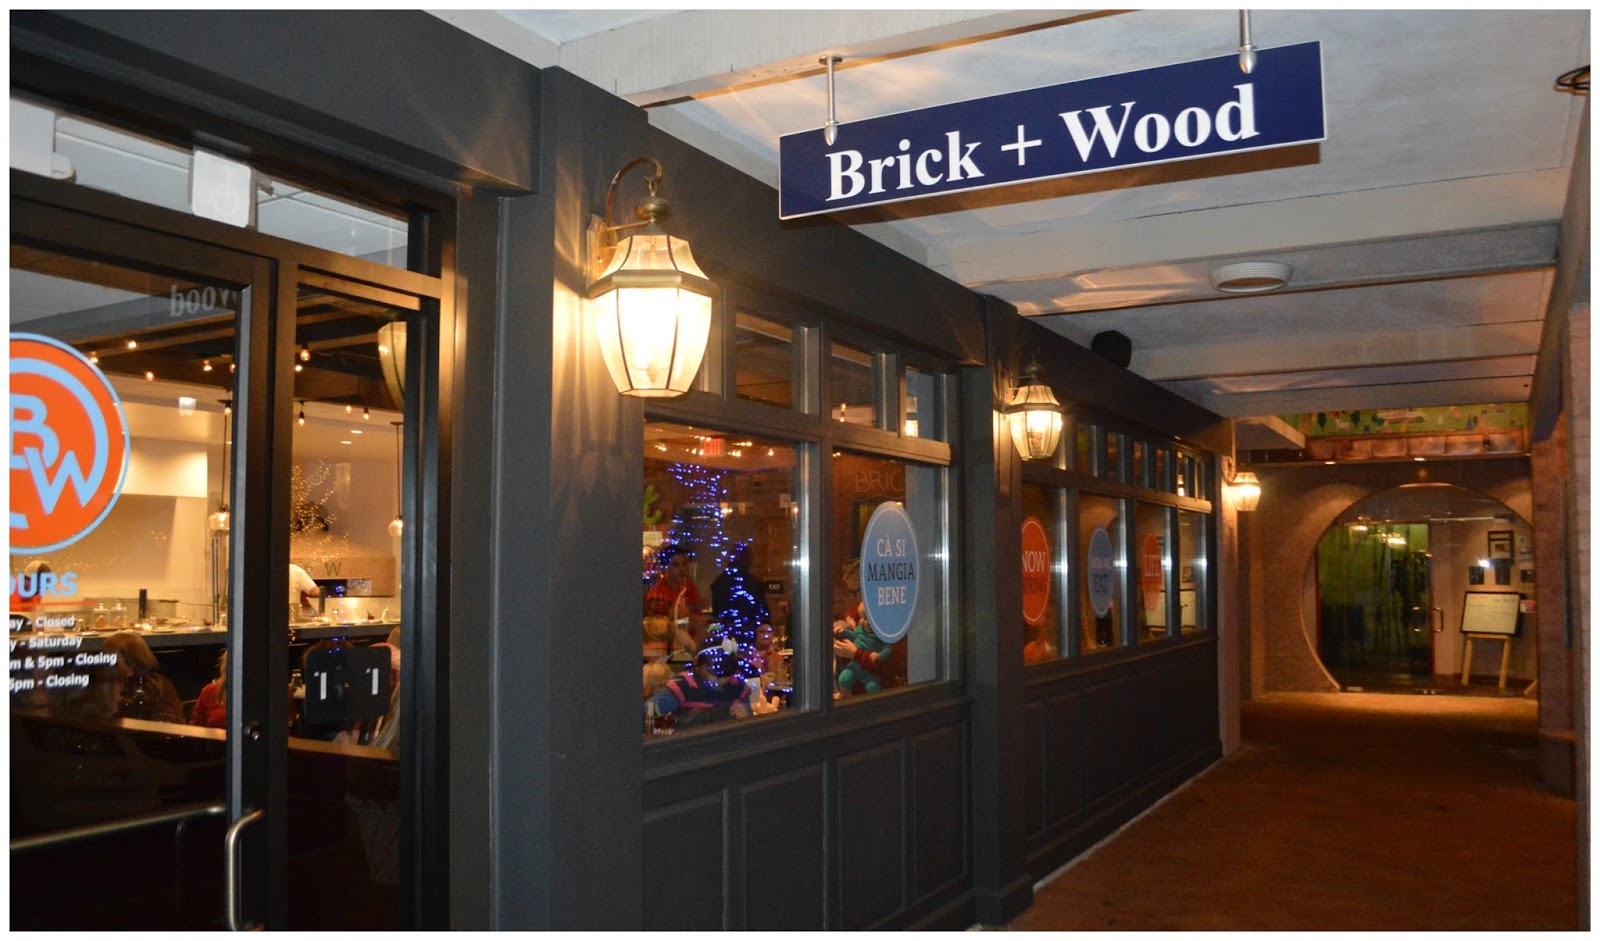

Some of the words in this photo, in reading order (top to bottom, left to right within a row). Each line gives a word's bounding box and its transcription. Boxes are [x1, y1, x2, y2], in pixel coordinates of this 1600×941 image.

[825, 131, 985, 202] Brick
[1000, 124, 1042, 166] +
[1058, 83, 1260, 163] Wood
[896, 539, 906, 557] SI
[1022, 550, 1046, 573] NOW
[867, 562, 915, 582] MANGIA
[10, 571, 78, 599] URS
[878, 586, 907, 606] BENE
[35, 614, 77, 628] Closed
[28, 635, 83, 649] Saturday
[38, 655, 64, 670] 5pm
[75, 651, 118, 666] Closing
[46, 672, 90, 688] Closing
